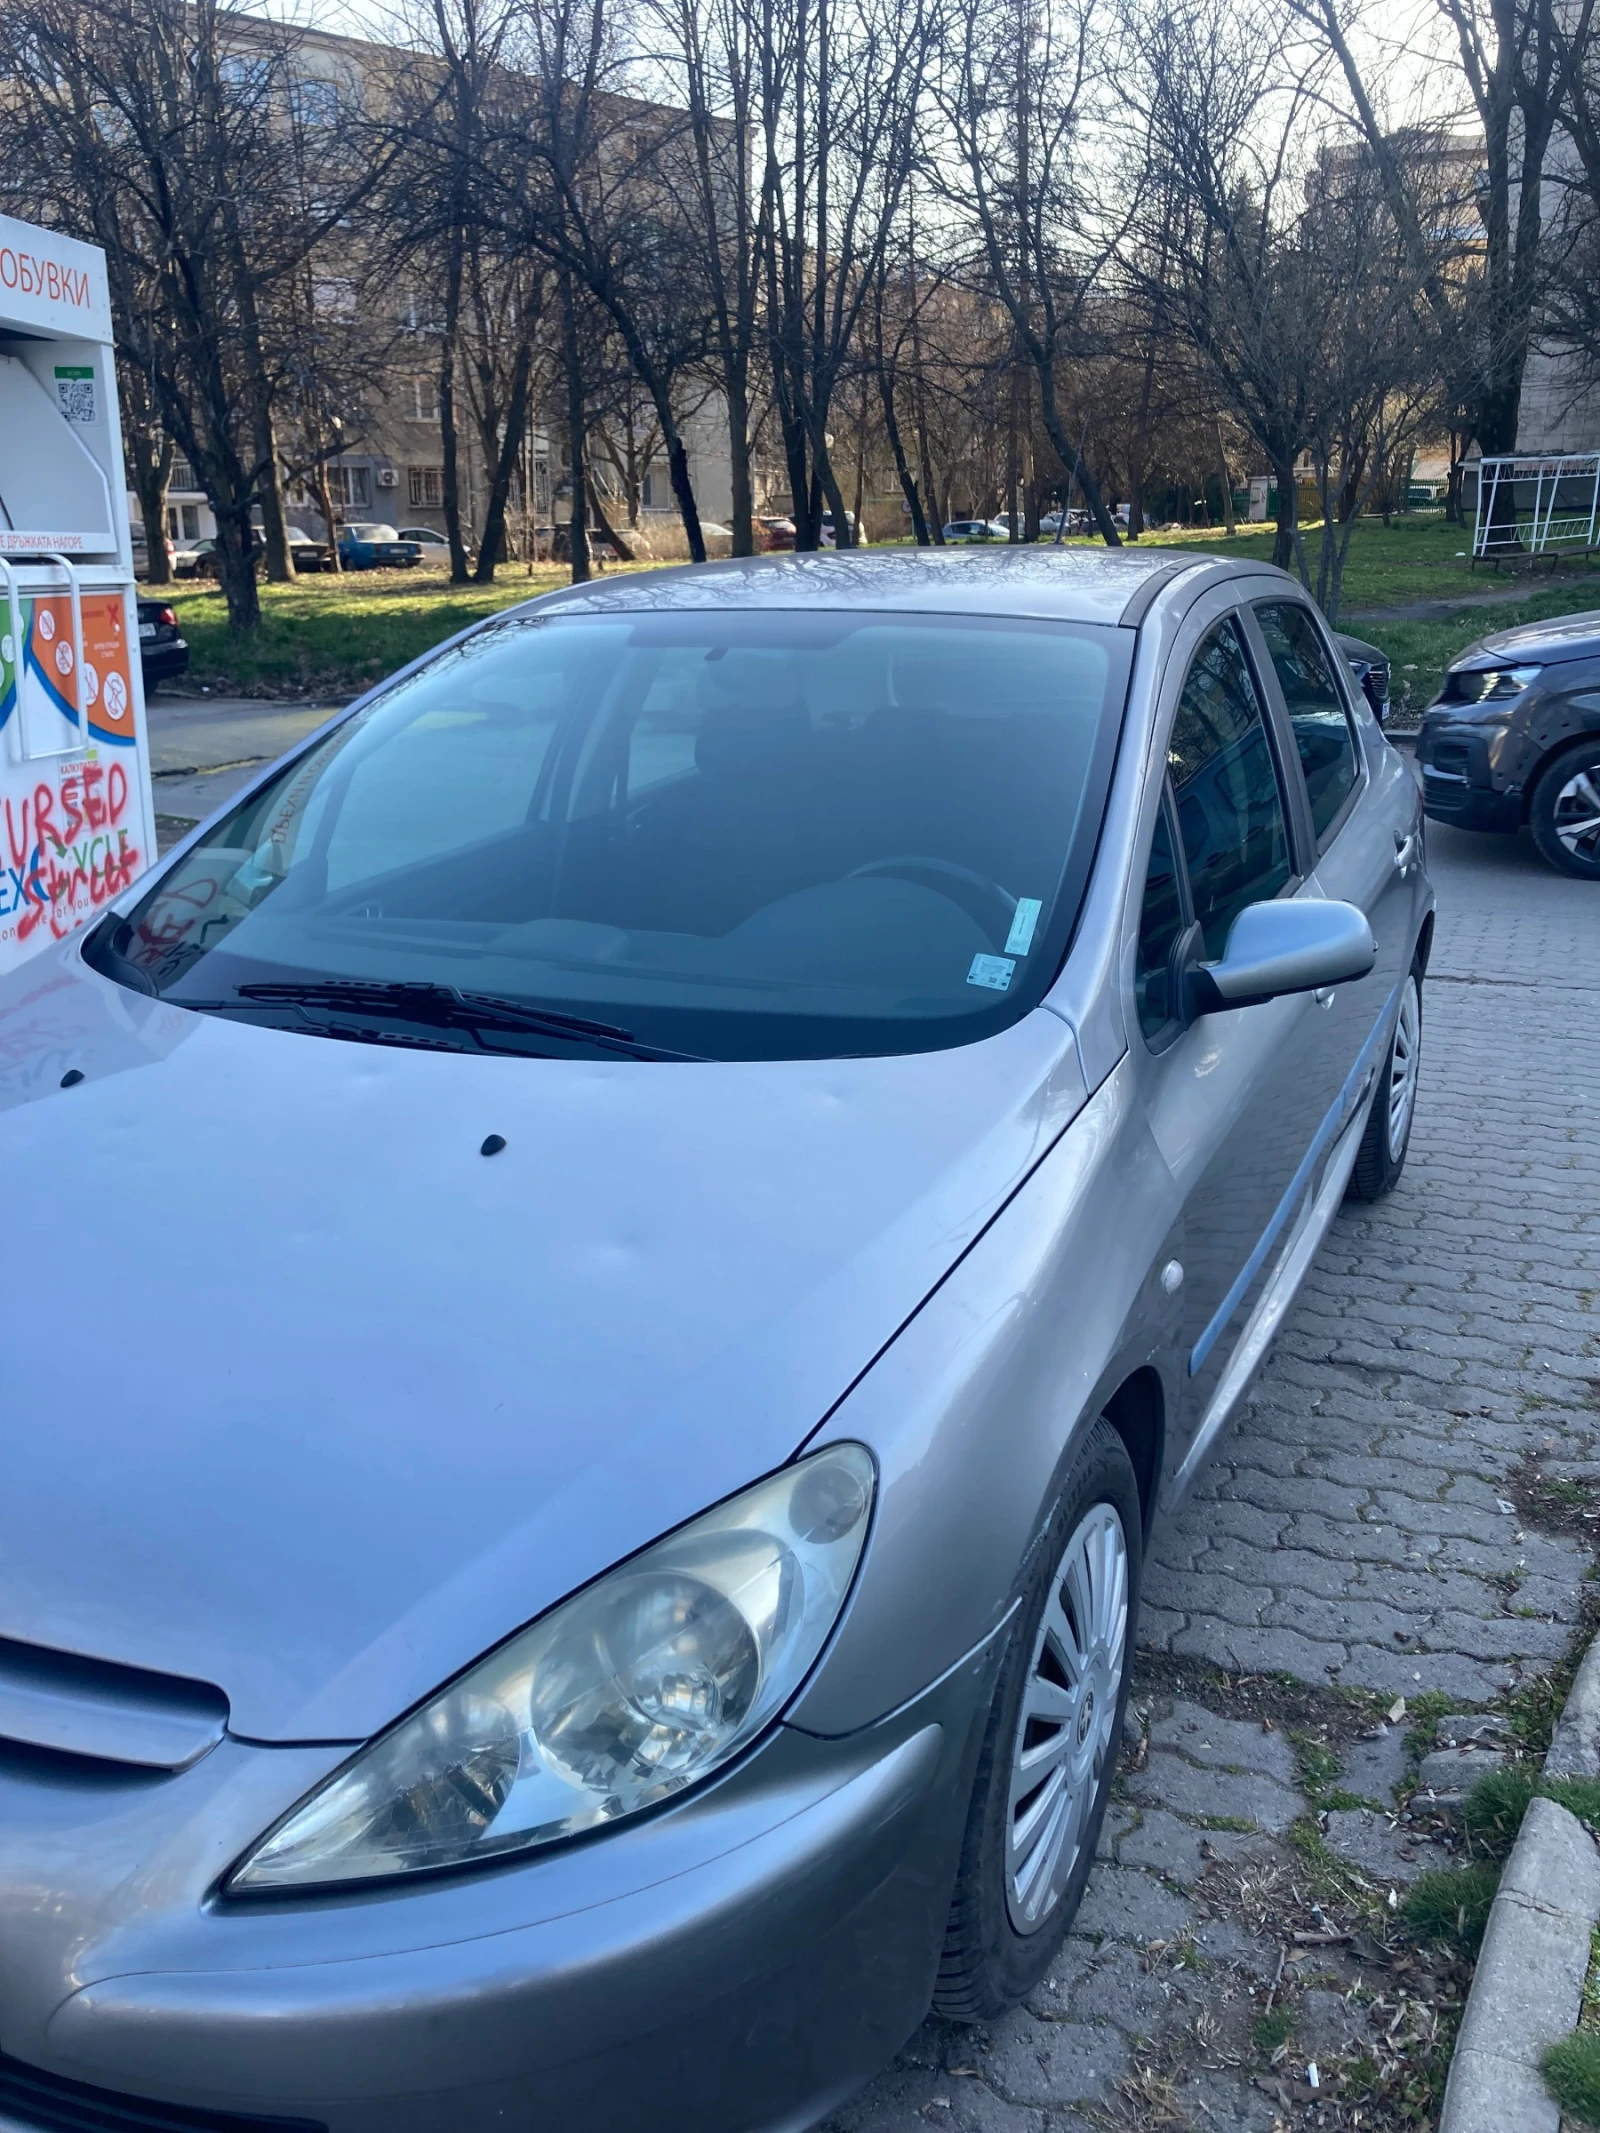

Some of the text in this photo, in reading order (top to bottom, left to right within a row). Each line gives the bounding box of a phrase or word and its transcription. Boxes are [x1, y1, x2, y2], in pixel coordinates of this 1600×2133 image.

[0, 248, 90, 309] ОБУВКИ
[7, 535, 53, 550] ДРЪЖКАТА
[54, 536, 83, 550] НАГОРЕ
[0, 763, 127, 869] URSED
